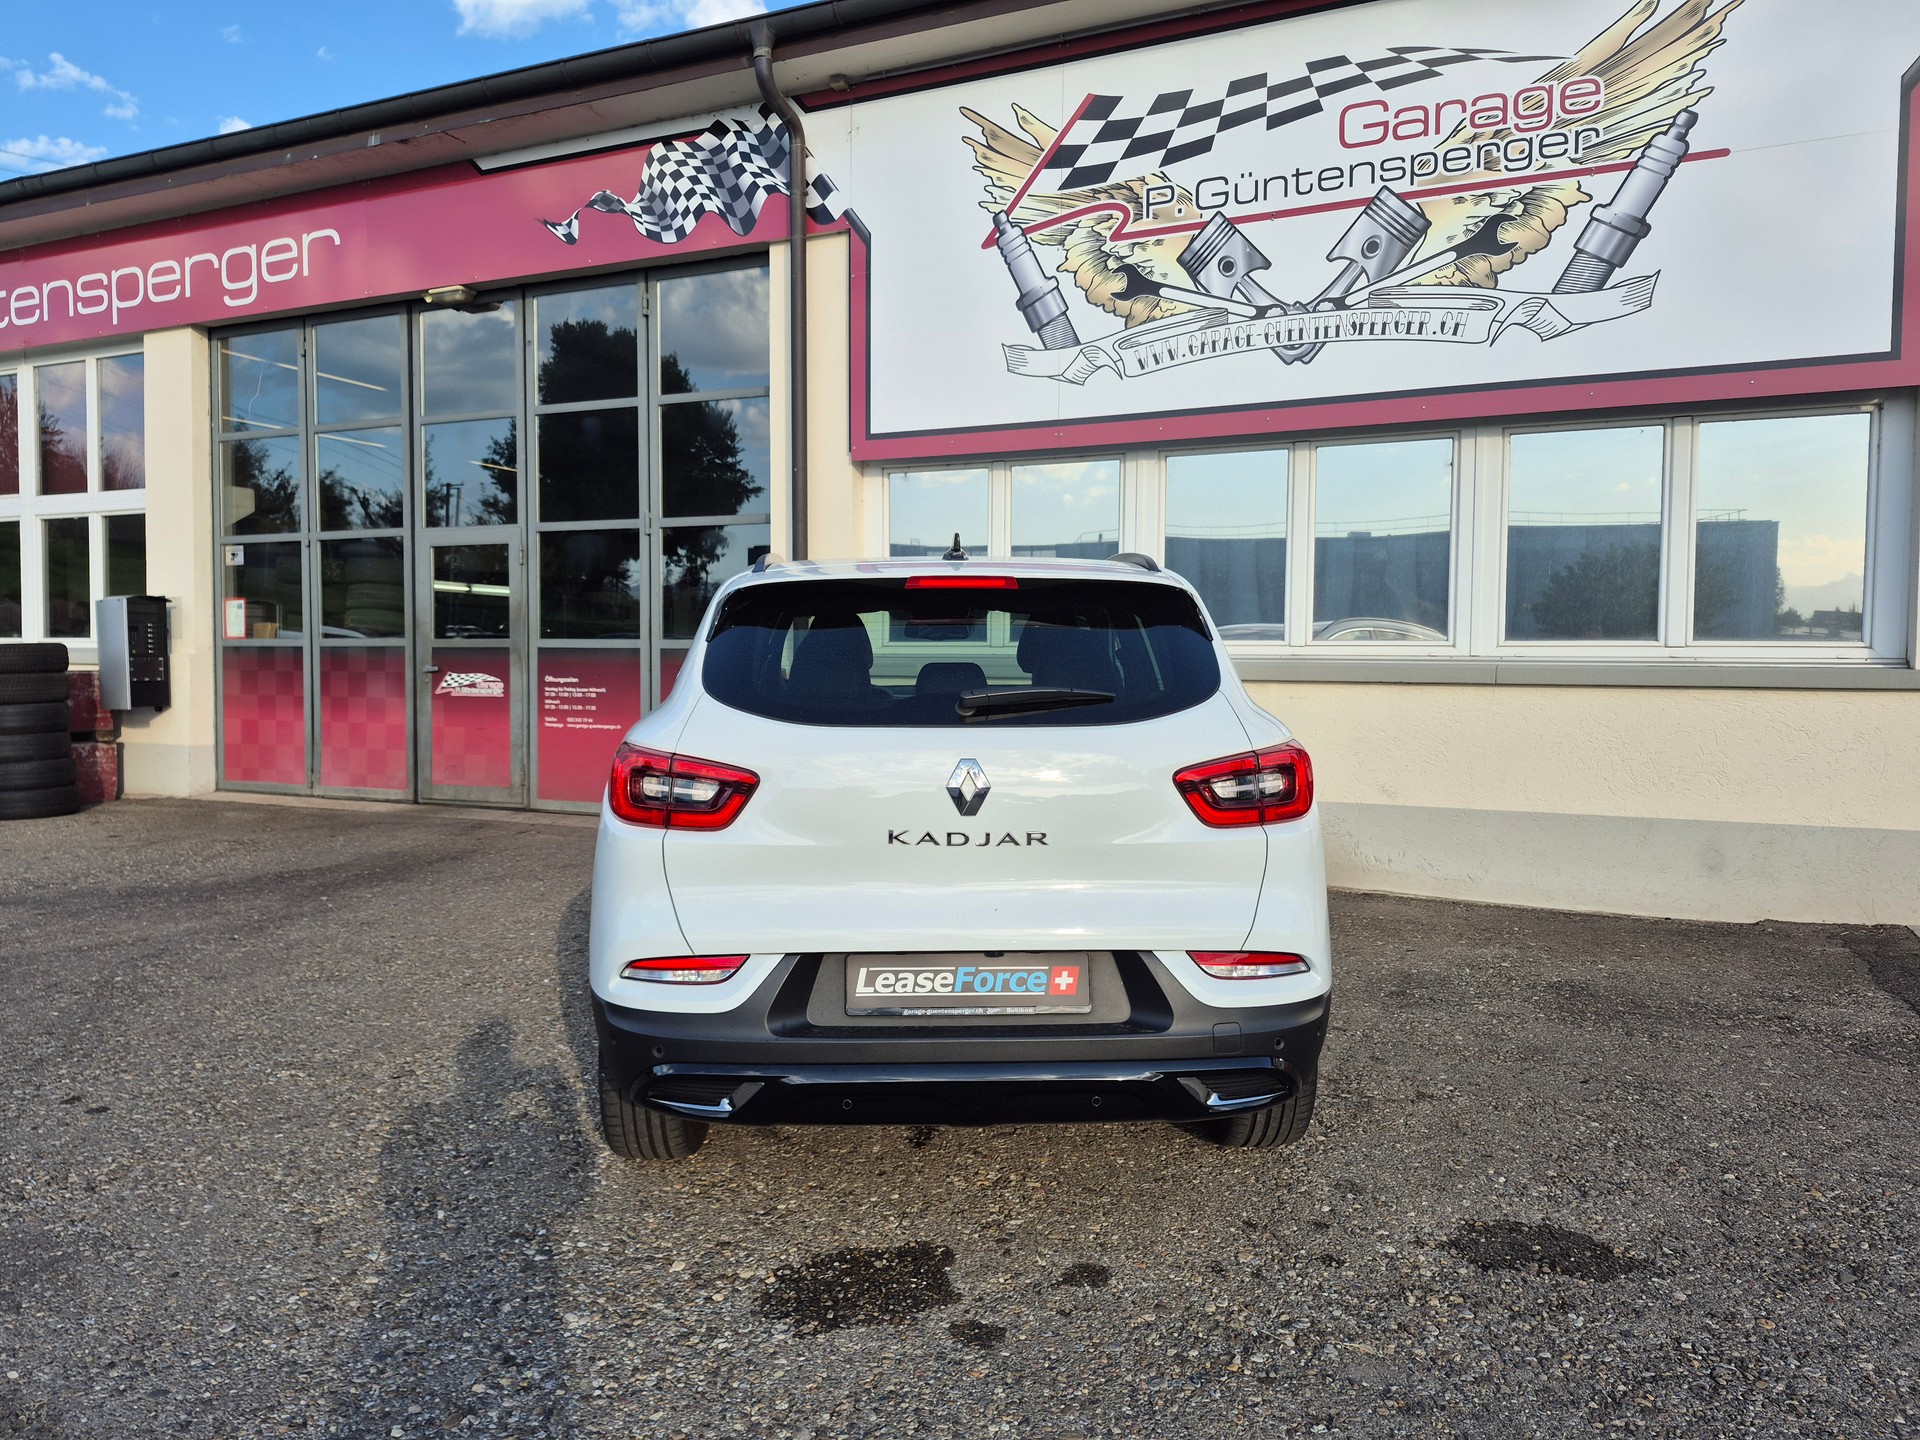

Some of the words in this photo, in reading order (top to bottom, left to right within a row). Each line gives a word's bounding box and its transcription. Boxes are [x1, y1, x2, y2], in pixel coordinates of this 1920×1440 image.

[1338, 77, 1602, 149] Garage
[1133, 311, 1471, 371] WWW.GARAGE-GUENTENSPERGER.CH
[888, 829, 1049, 847] KADJAR
[855, 966, 1047, 993] LeaseForce
